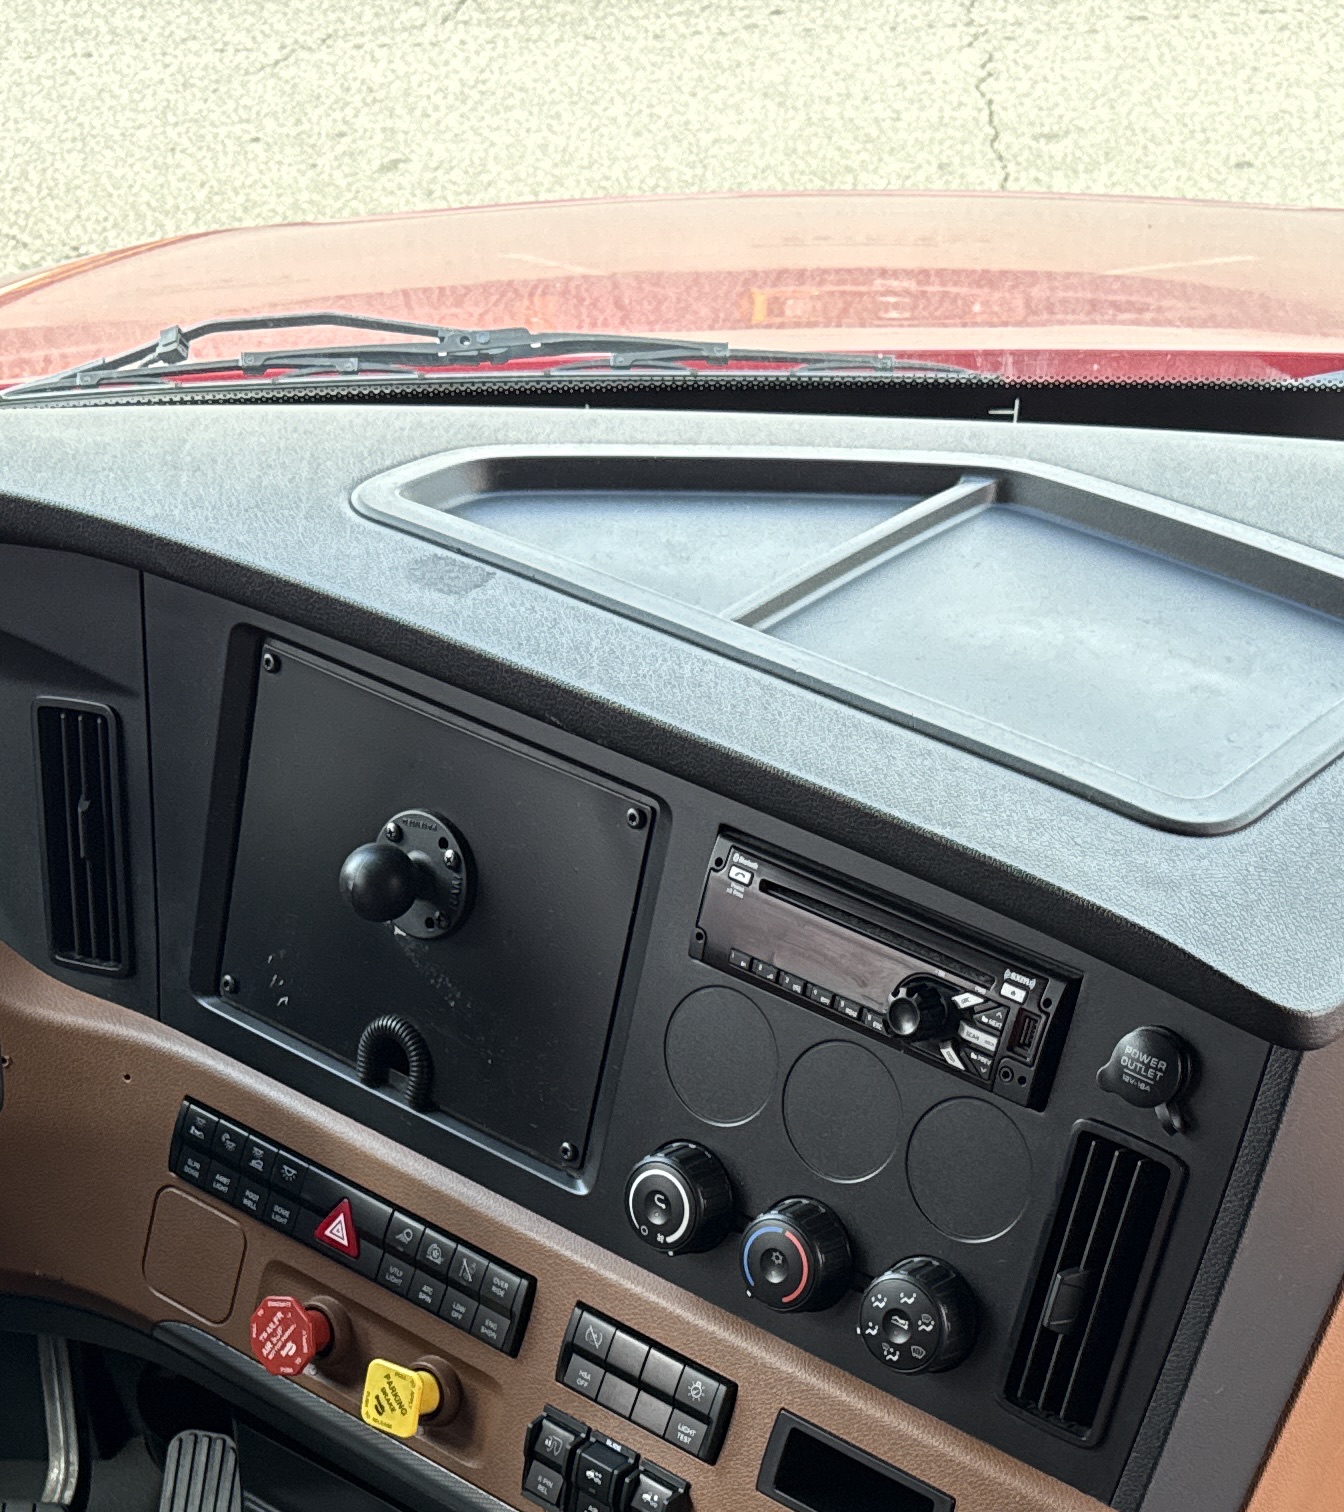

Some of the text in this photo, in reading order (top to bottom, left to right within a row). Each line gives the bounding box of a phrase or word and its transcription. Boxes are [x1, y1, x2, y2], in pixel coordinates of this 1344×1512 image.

[1124, 1045, 1167, 1071] POWER
[1120, 1056, 1163, 1082] OUTLET
[492, 1276, 509, 1290] OVER
[576, 1378, 589, 1387] OFF
[381, 1387, 396, 1413] BRAKE
[384, 1373, 407, 1416] PARKING
[677, 1422, 697, 1437] LIGHT
[677, 1432, 692, 1445] TEST
